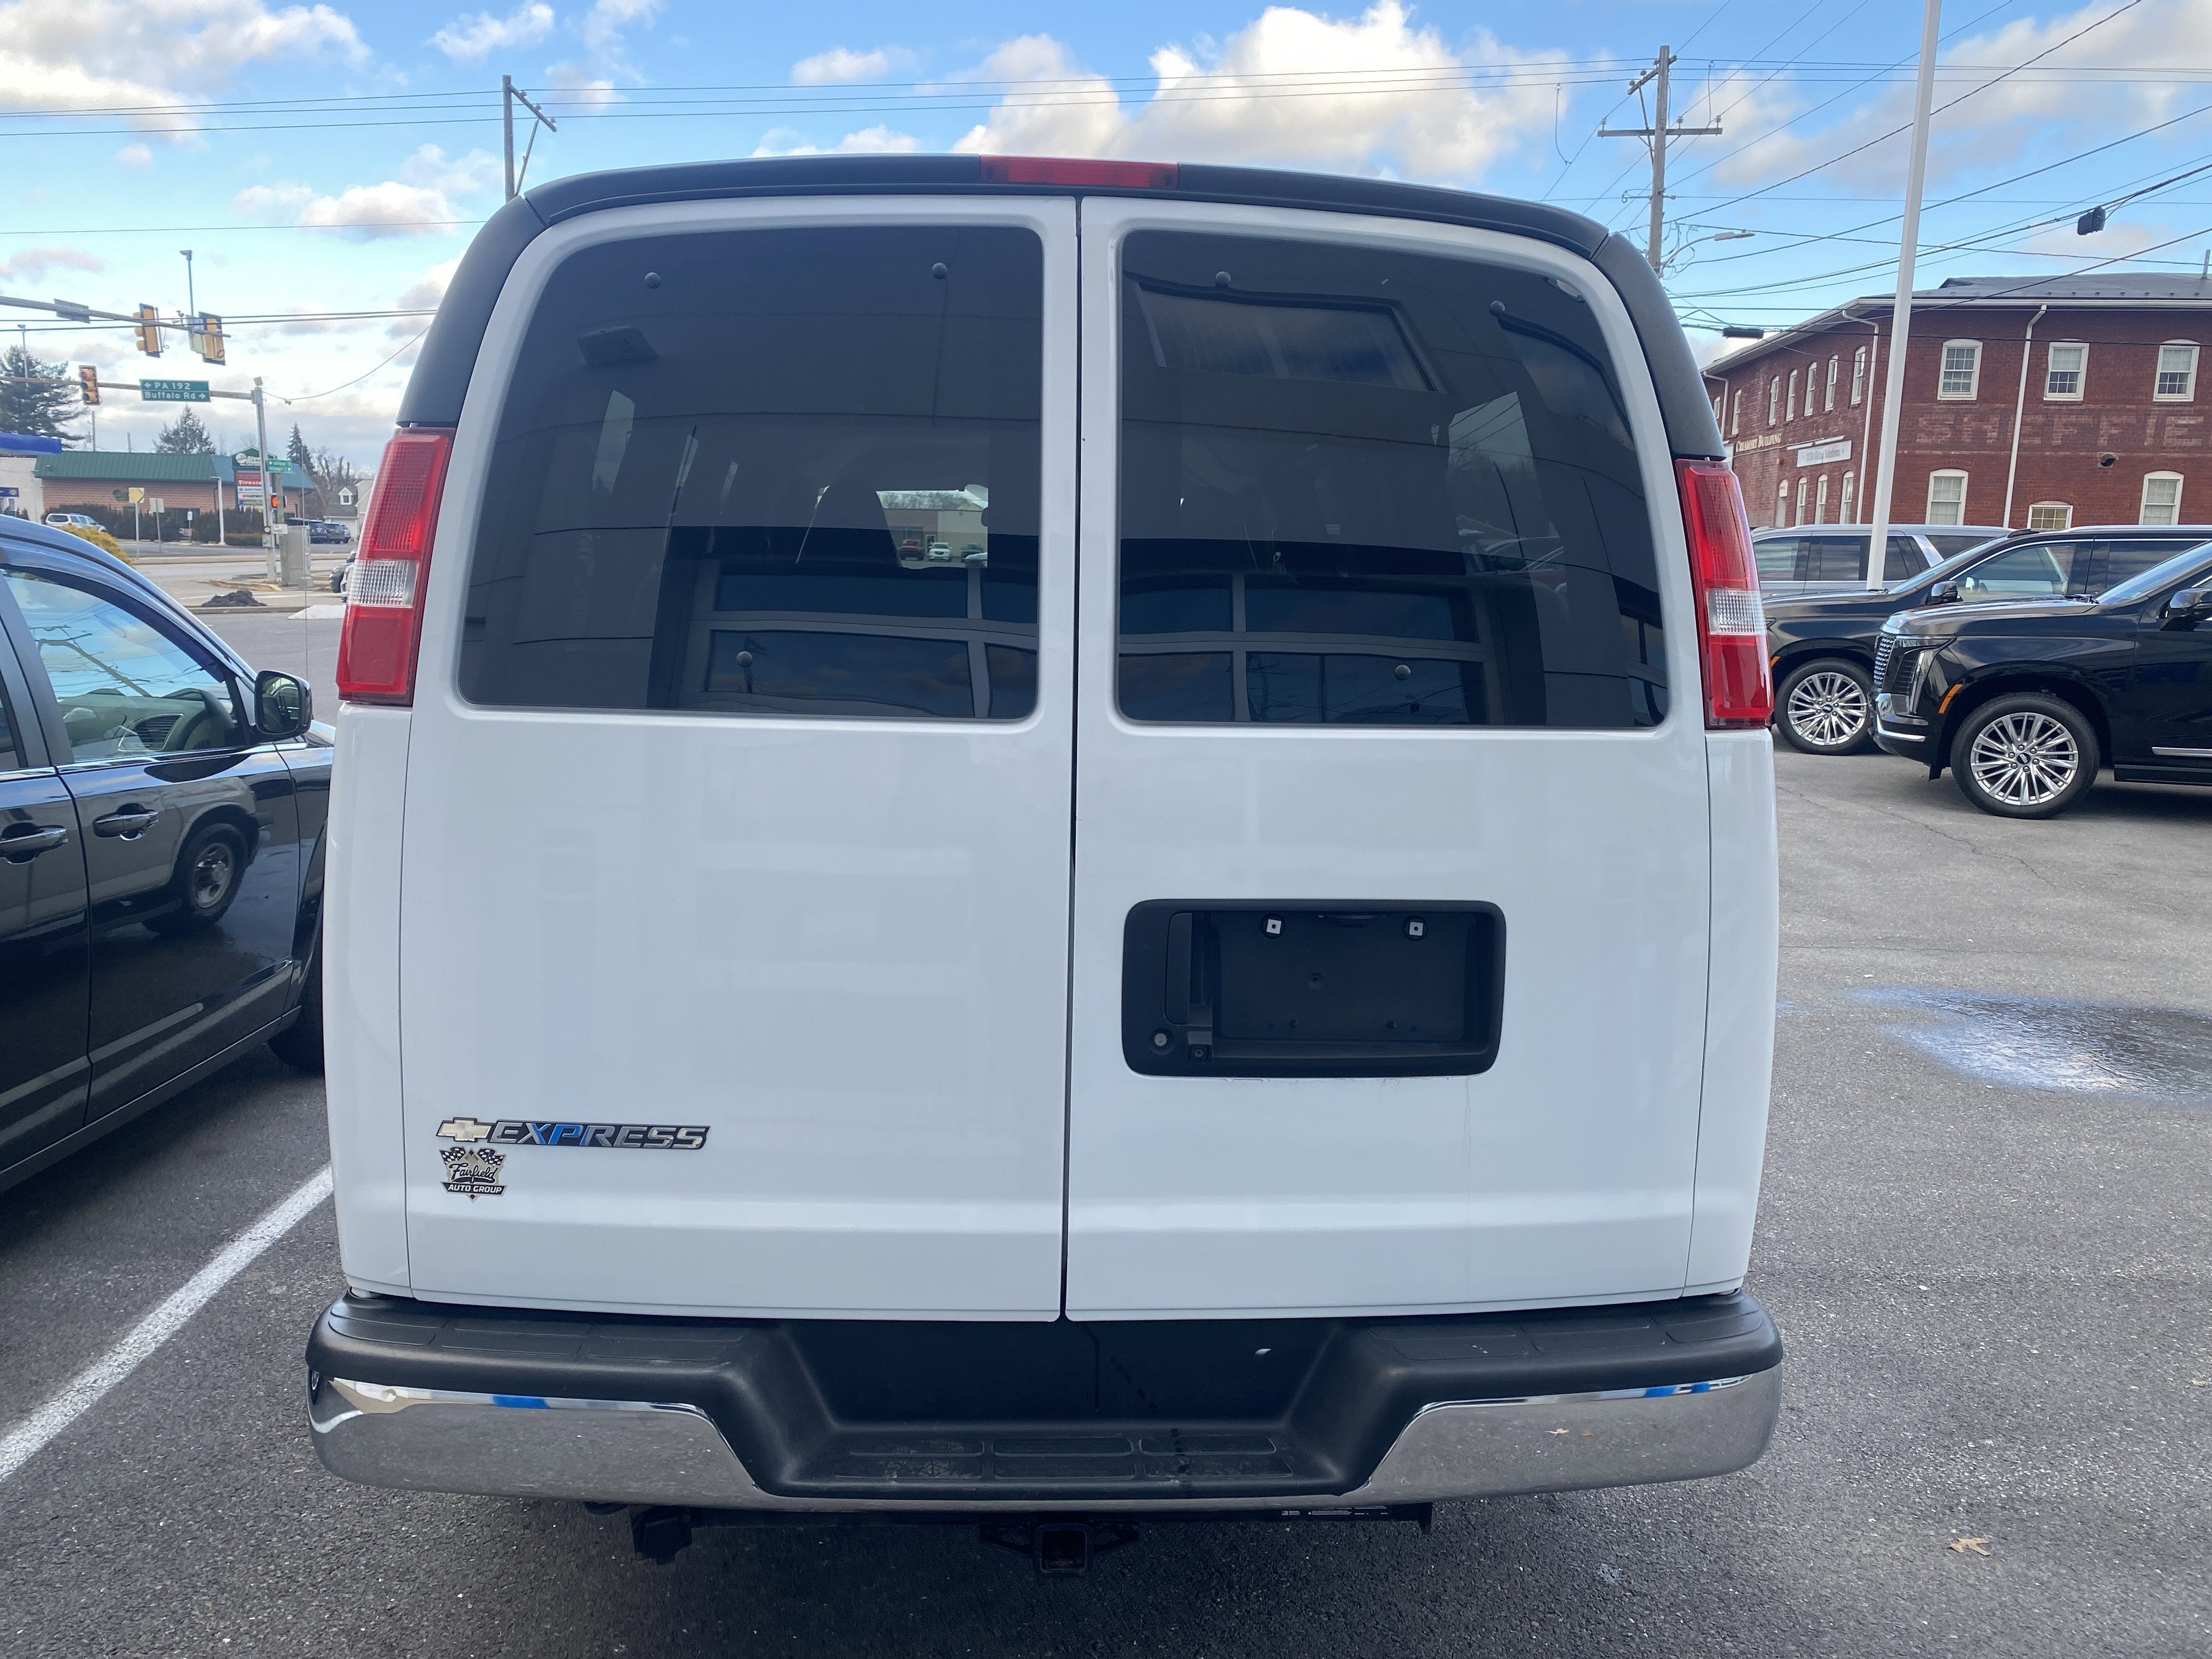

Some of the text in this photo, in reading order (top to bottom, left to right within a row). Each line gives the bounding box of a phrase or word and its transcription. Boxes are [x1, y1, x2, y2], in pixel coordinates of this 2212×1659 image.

[172, 382, 191, 390] 192
[490, 1121, 707, 1148] EXPRESS
[449, 1163, 498, 1183] Fairfield
[473, 1185, 503, 1193] GROUP
